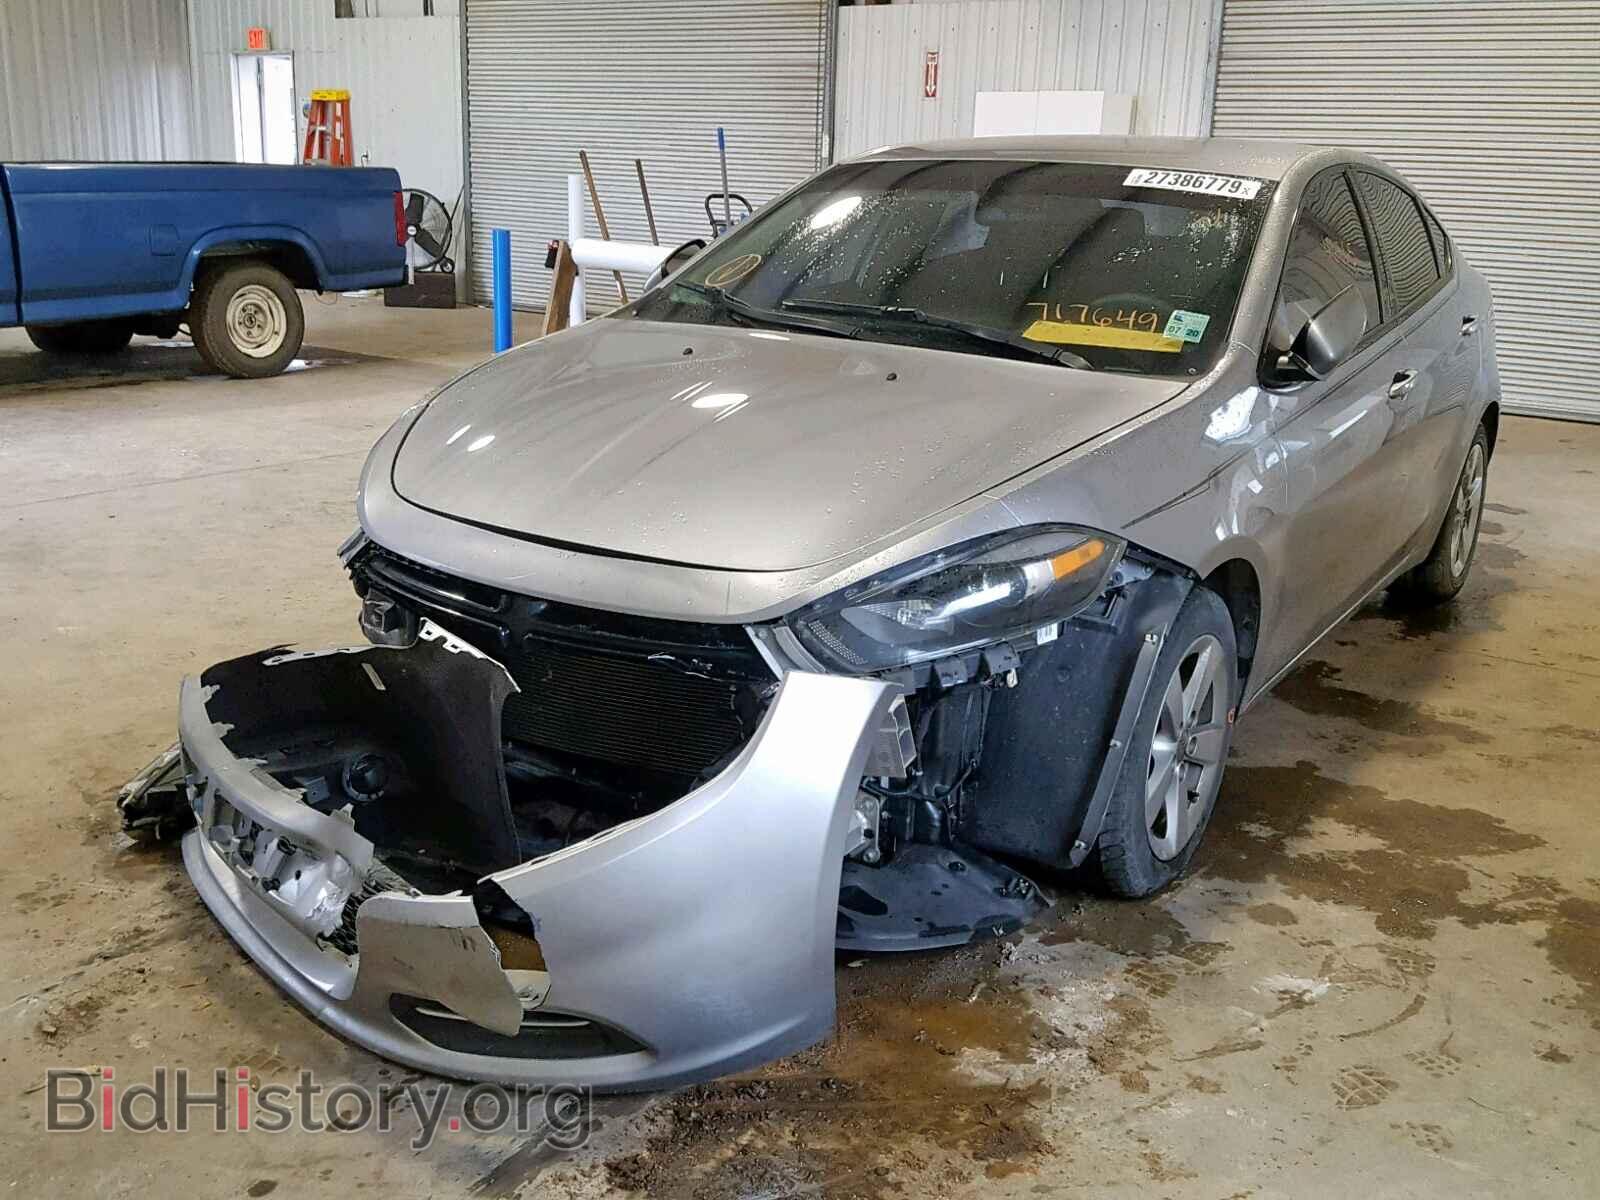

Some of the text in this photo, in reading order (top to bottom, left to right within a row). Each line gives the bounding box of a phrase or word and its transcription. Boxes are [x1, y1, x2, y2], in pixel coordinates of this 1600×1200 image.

[1143, 171, 1242, 194] 27386779
[1026, 302, 1158, 333] 717649
[1185, 328, 1200, 338] 20
